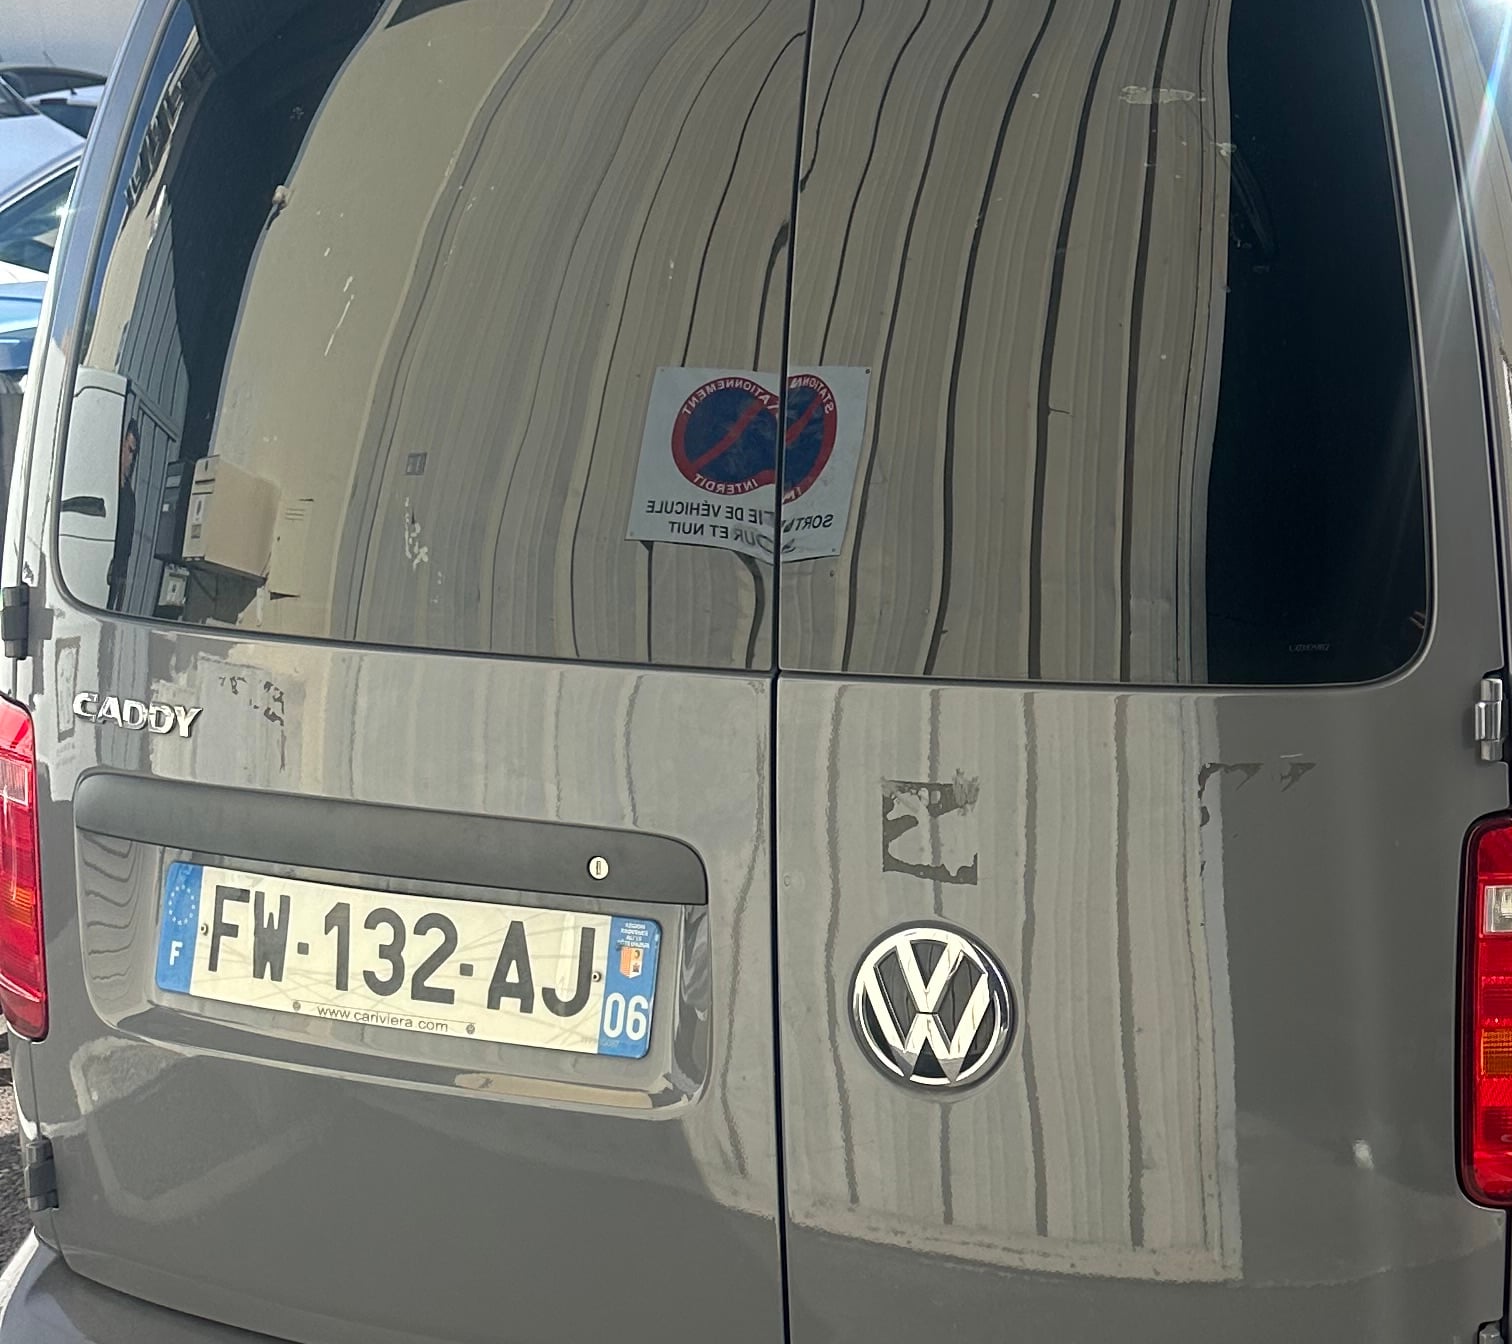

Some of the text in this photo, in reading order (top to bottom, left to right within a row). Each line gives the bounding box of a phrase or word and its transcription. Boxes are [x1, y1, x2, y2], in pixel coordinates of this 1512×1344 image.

[73, 691, 203, 738] CADDY
[169, 885, 649, 1041] F FW-132-AJ 06
[855, 928, 1009, 1086] VW
